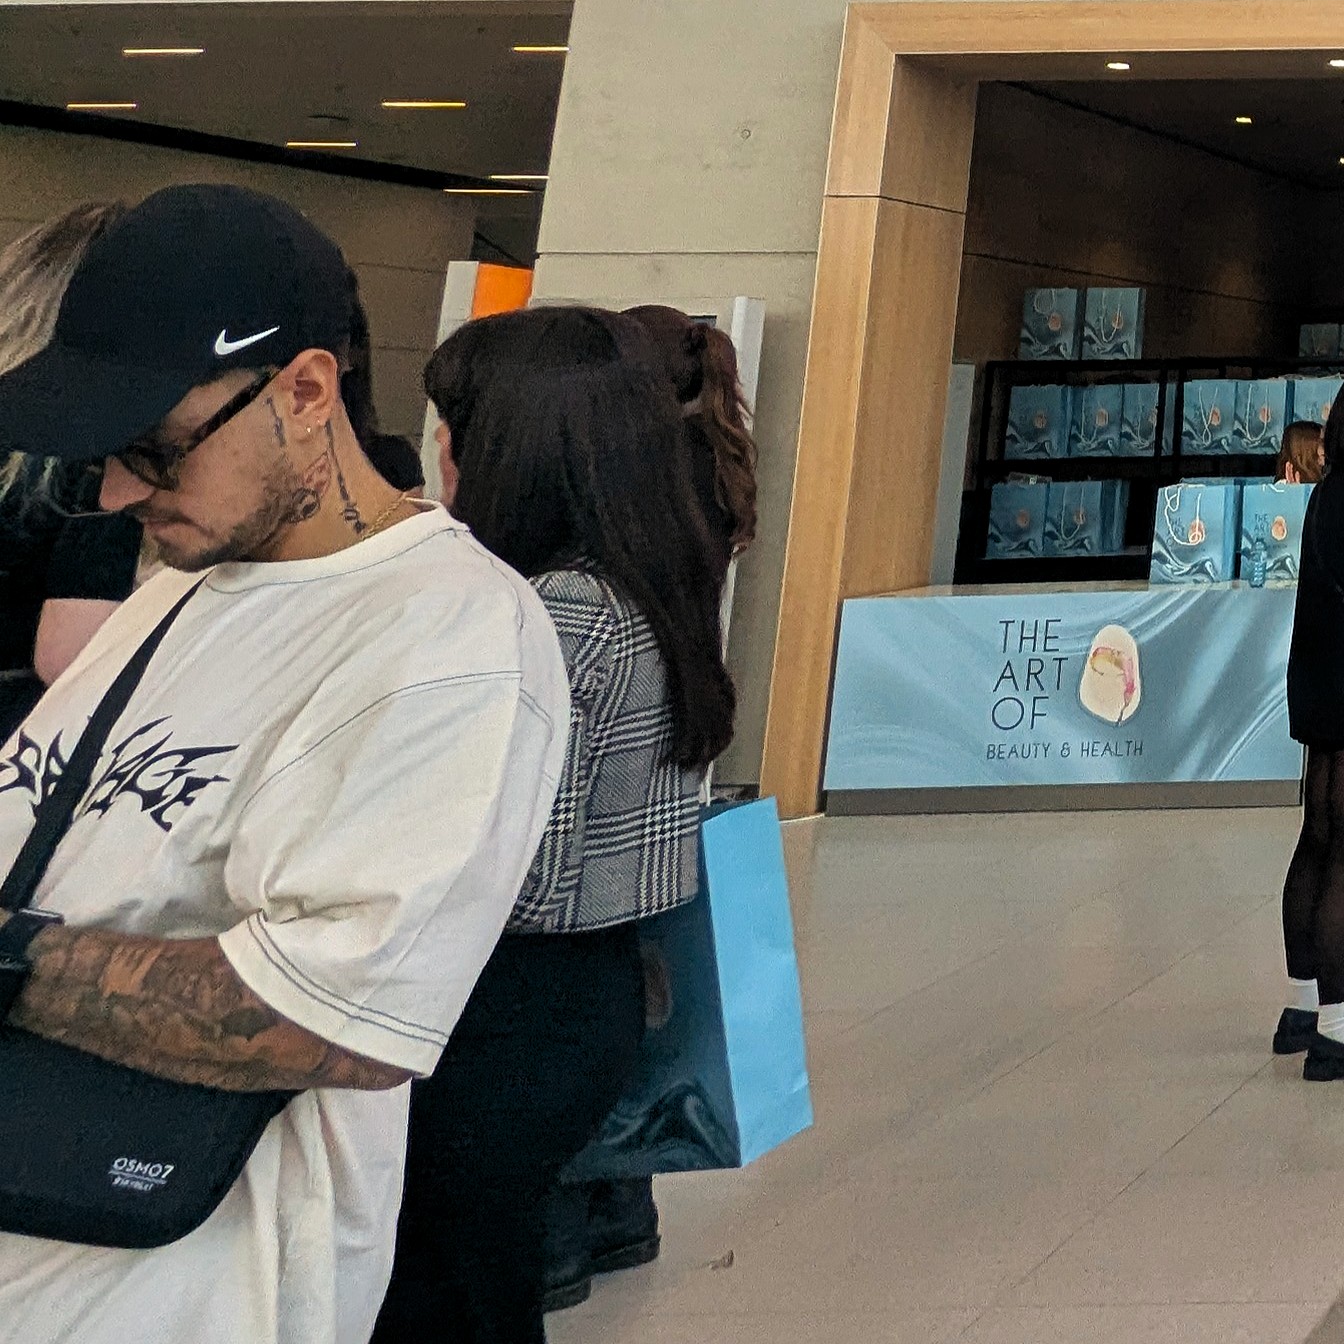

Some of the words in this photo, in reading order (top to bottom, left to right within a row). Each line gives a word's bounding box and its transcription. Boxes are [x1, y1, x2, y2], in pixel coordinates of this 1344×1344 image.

[999, 619, 1061, 653] THE
[993, 657, 1068, 692] ART
[991, 696, 1049, 730] OF
[986, 742, 1051, 760] BEAUTY
[1060, 741, 1071, 758] &
[1081, 740, 1145, 757] HEALTH
